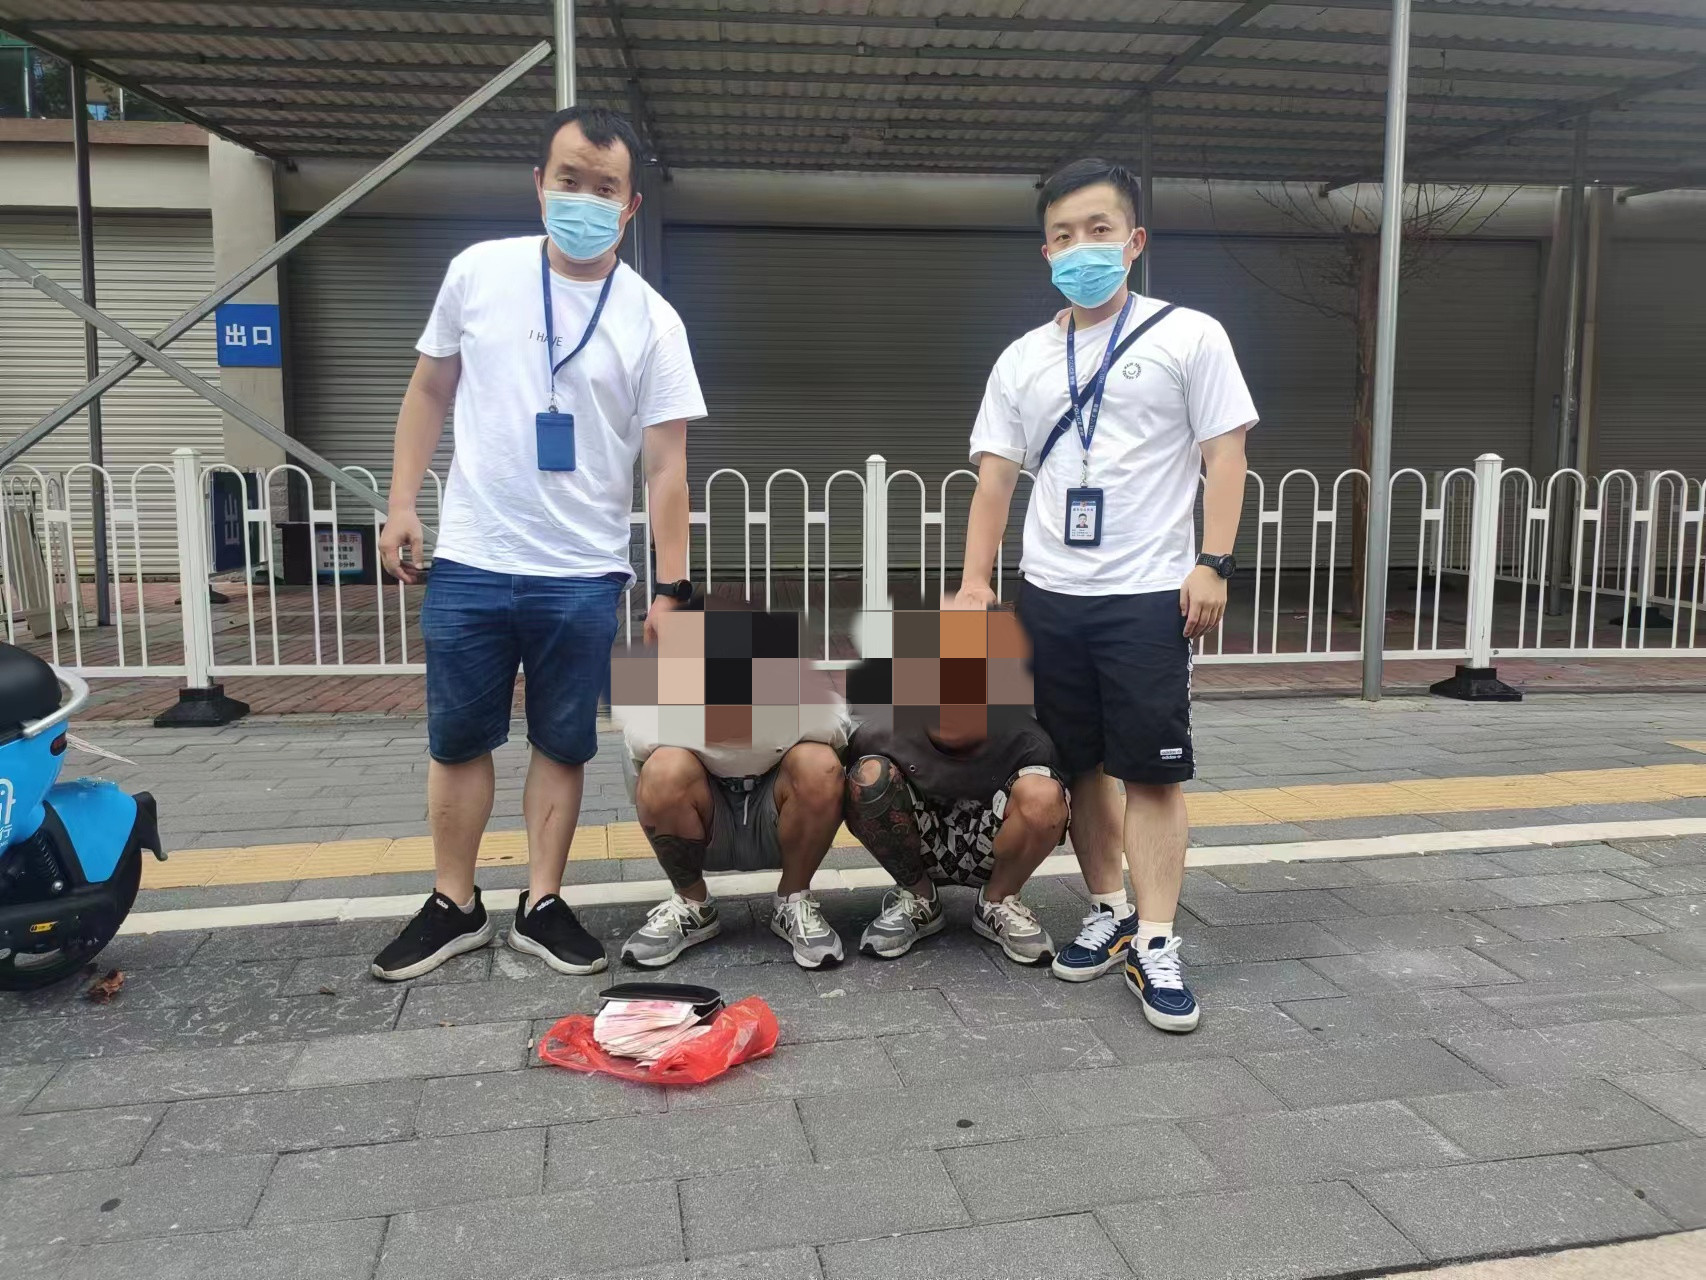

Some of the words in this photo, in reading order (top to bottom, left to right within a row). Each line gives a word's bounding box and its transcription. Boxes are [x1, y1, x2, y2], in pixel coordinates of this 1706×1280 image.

[225, 323, 272, 346] 出口
[529, 330, 534, 339] I
[1074, 404, 1083, 427] POLICE
[909, 908, 930, 932] N
[986, 912, 1004, 936] N
